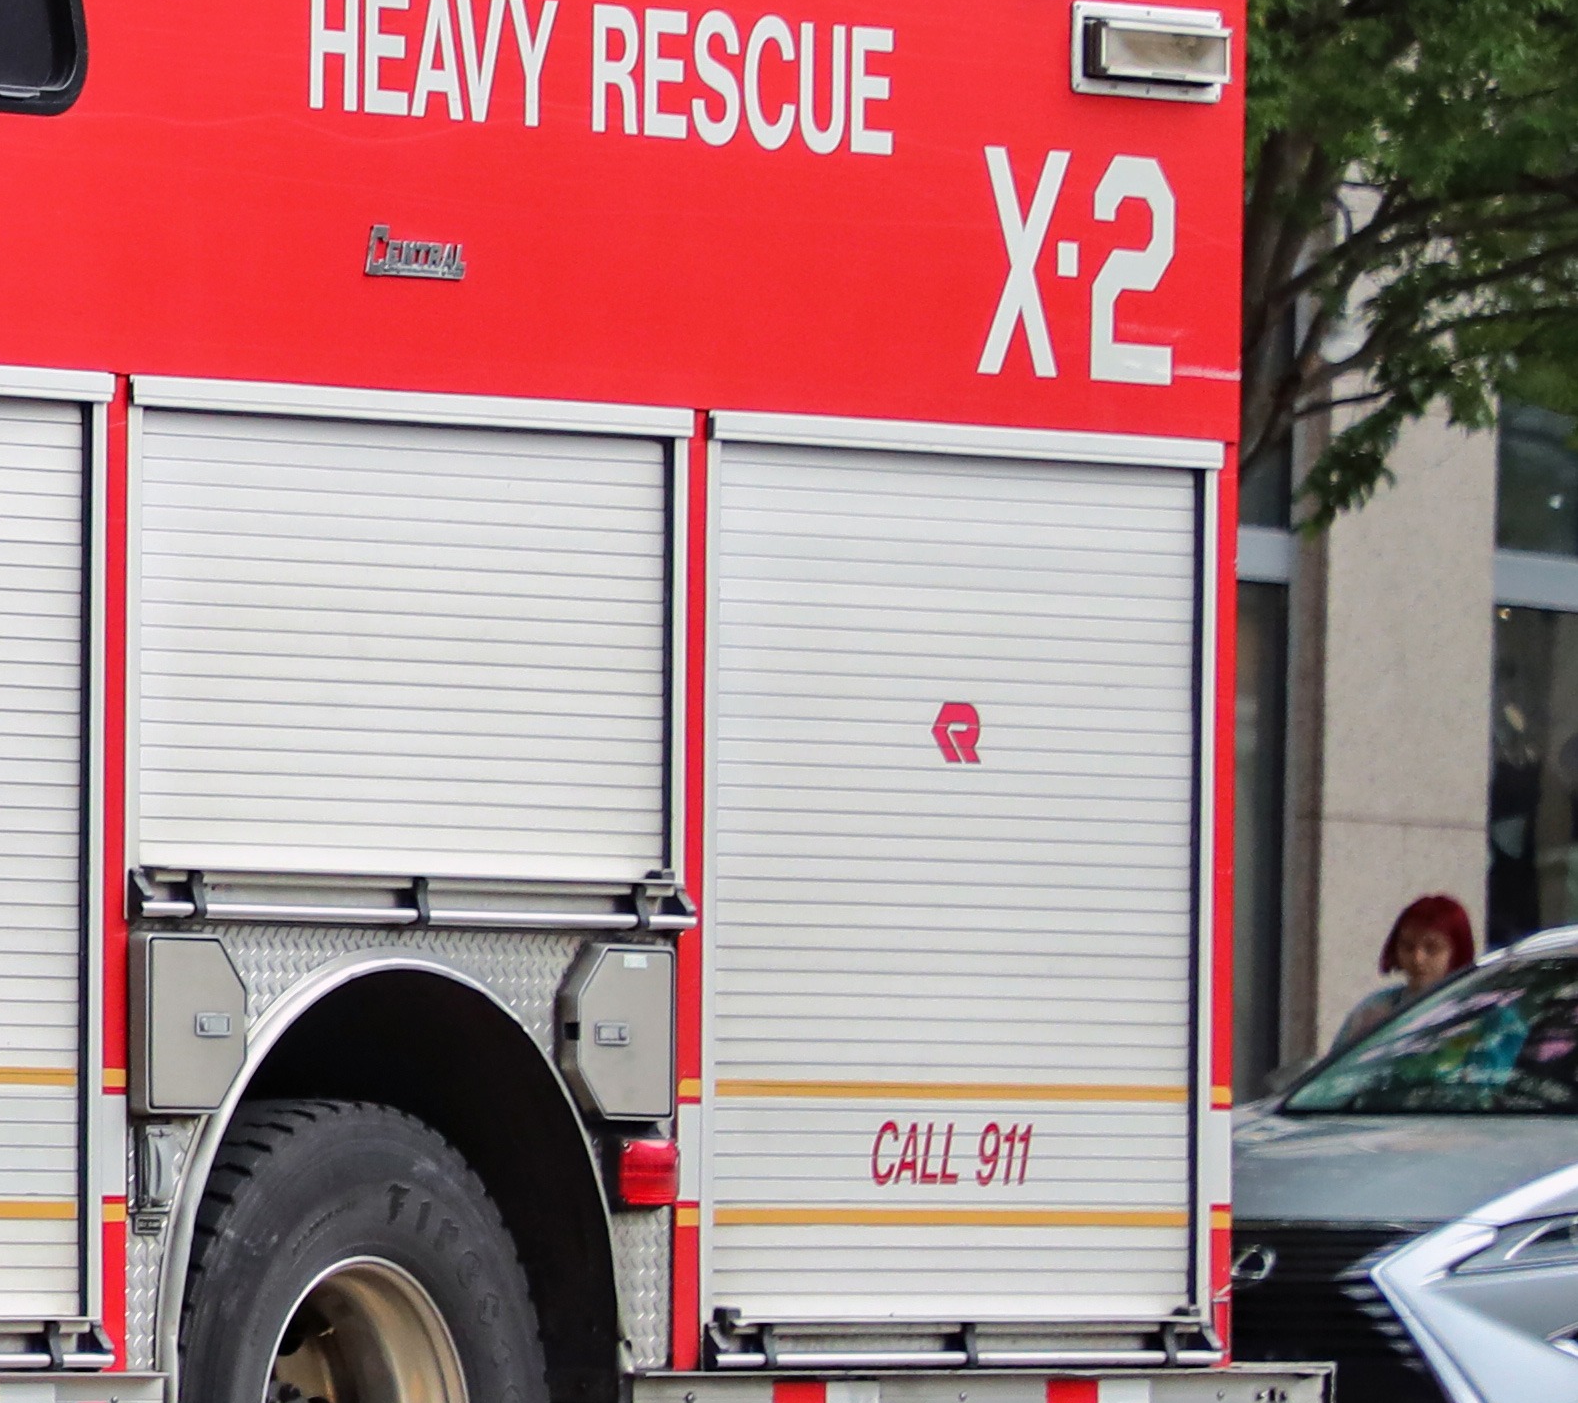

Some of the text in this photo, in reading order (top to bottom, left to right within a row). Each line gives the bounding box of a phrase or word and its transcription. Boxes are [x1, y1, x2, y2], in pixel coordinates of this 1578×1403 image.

[591, 3, 894, 156] RESCUE
[977, 145, 1177, 387] X-2
[870, 1120, 1034, 1187] CALL 911
